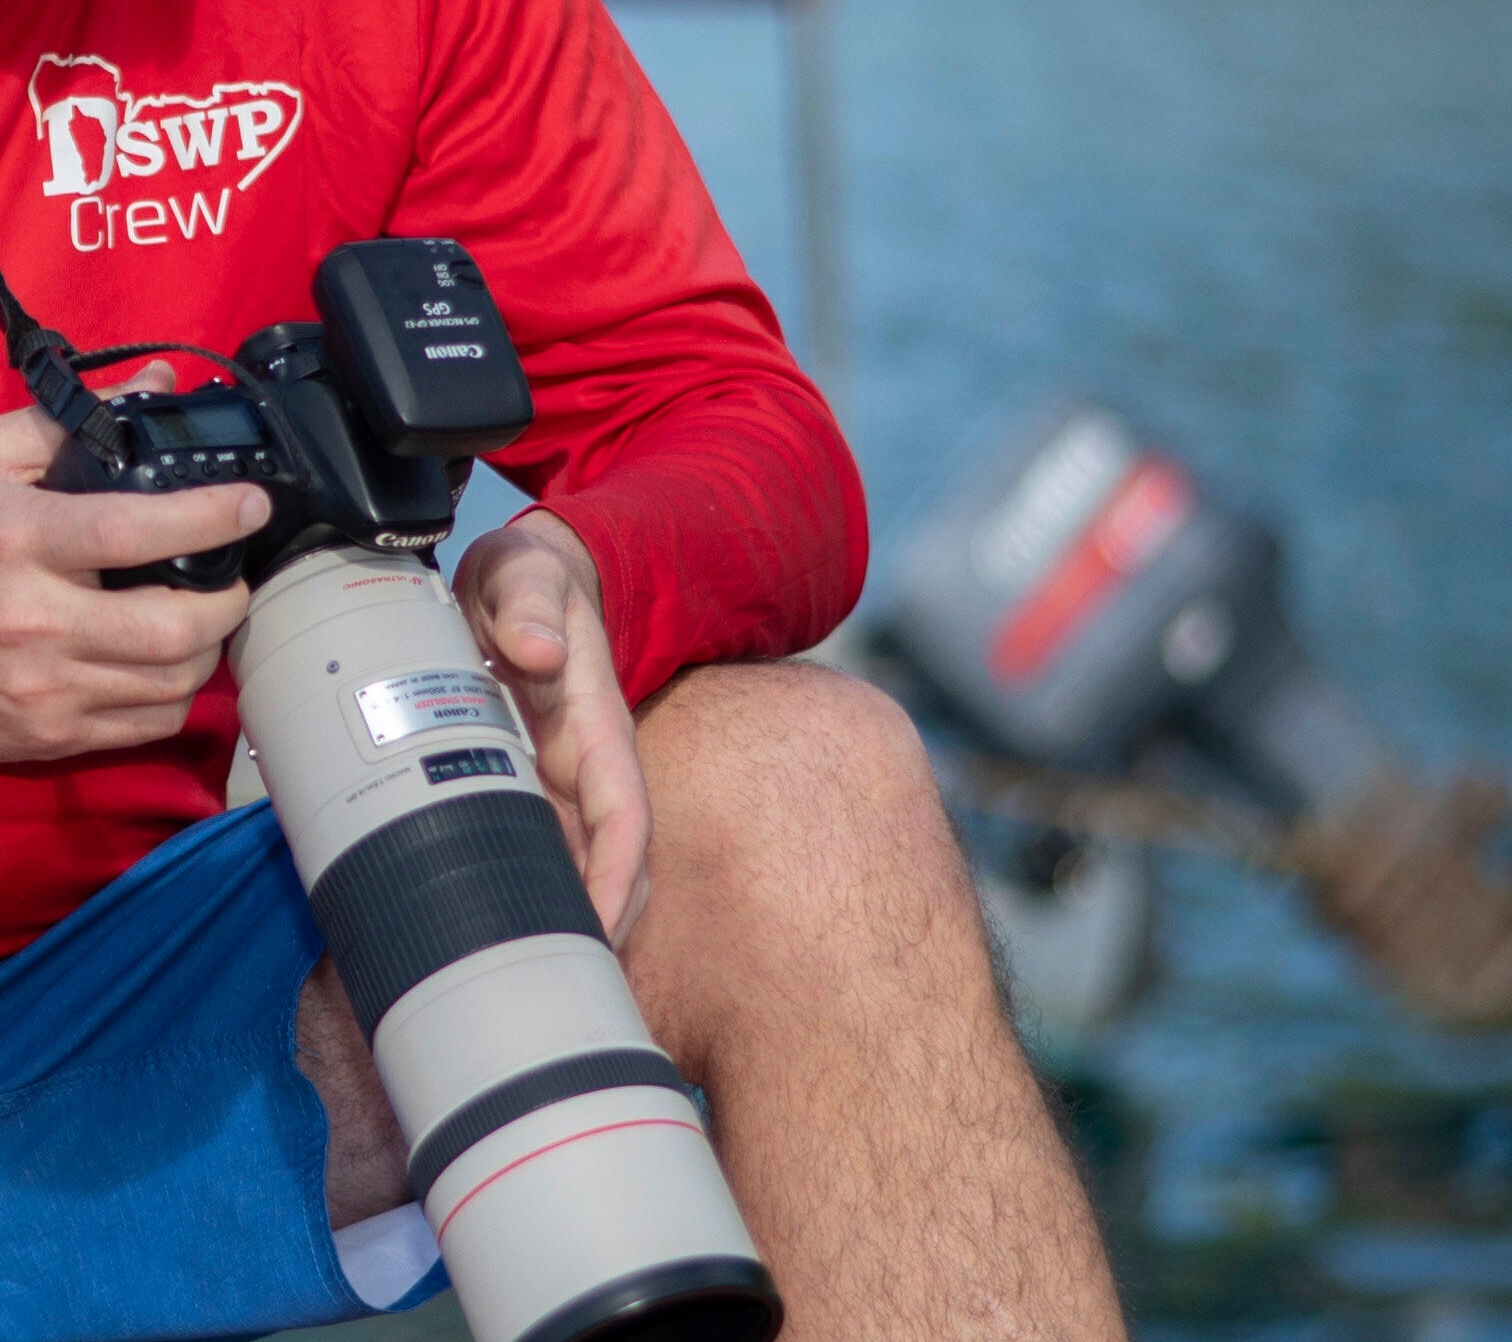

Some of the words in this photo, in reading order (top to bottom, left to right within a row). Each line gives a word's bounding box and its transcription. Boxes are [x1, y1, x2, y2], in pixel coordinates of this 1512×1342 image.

[42, 96, 284, 196] DSWP
[70, 188, 231, 253] Crew
[422, 302, 451, 316] GPS
[424, 344, 483, 359] Canon
[375, 530, 447, 548] Canon
[342, 575, 407, 591] ULTRASONIC
[433, 707, 480, 719] Canon
